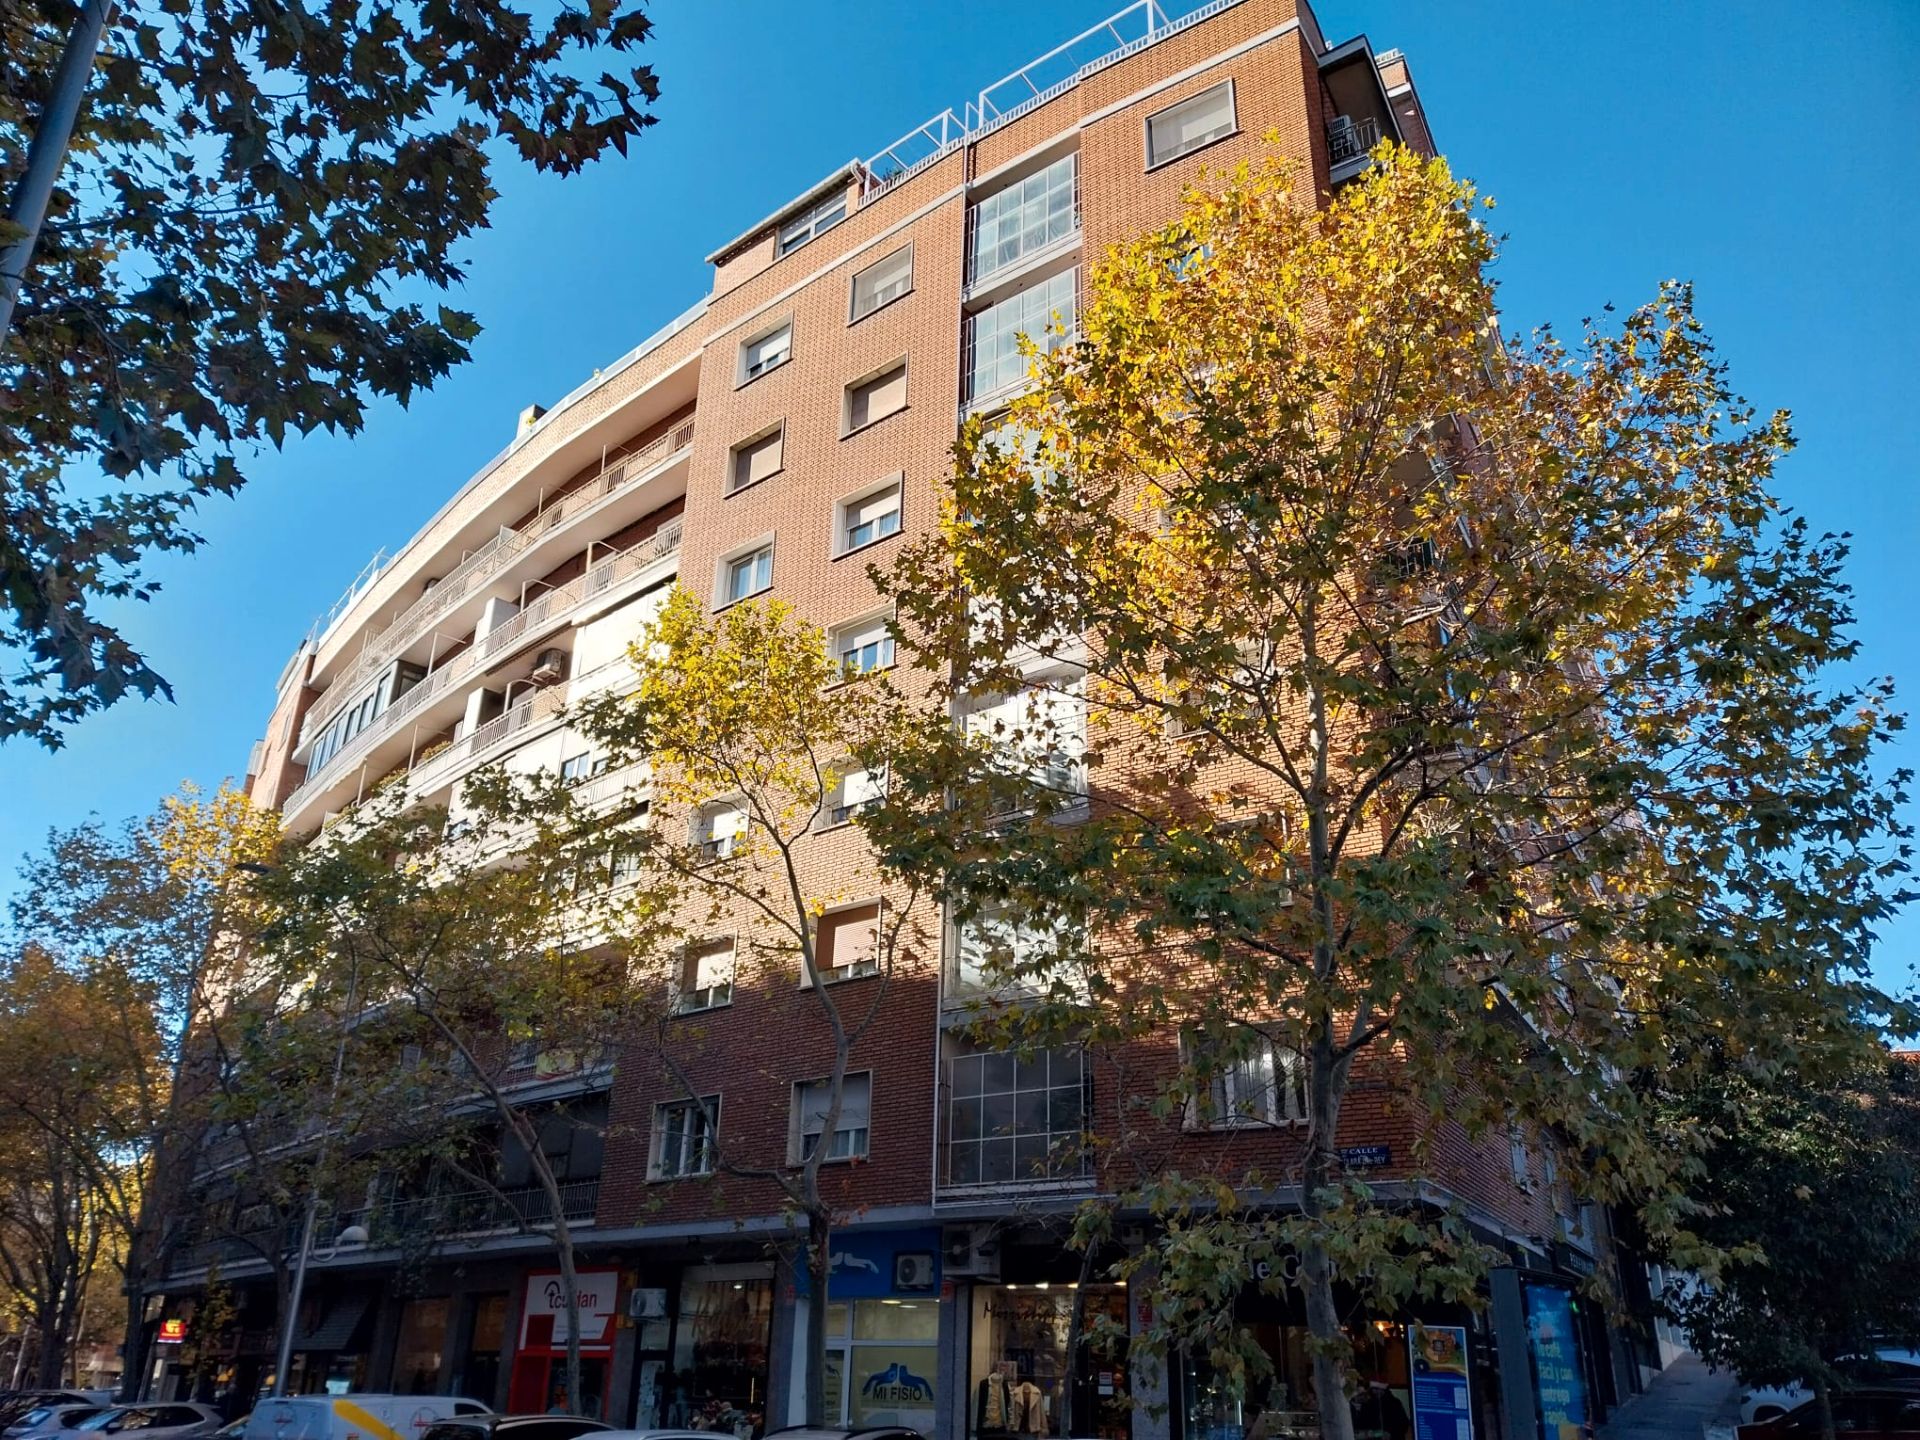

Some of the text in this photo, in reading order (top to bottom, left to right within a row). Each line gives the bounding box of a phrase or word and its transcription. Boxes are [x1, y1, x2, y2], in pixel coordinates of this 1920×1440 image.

[1348, 1147, 1379, 1155] CALLE
[873, 1387, 922, 1402] MI FISIO
